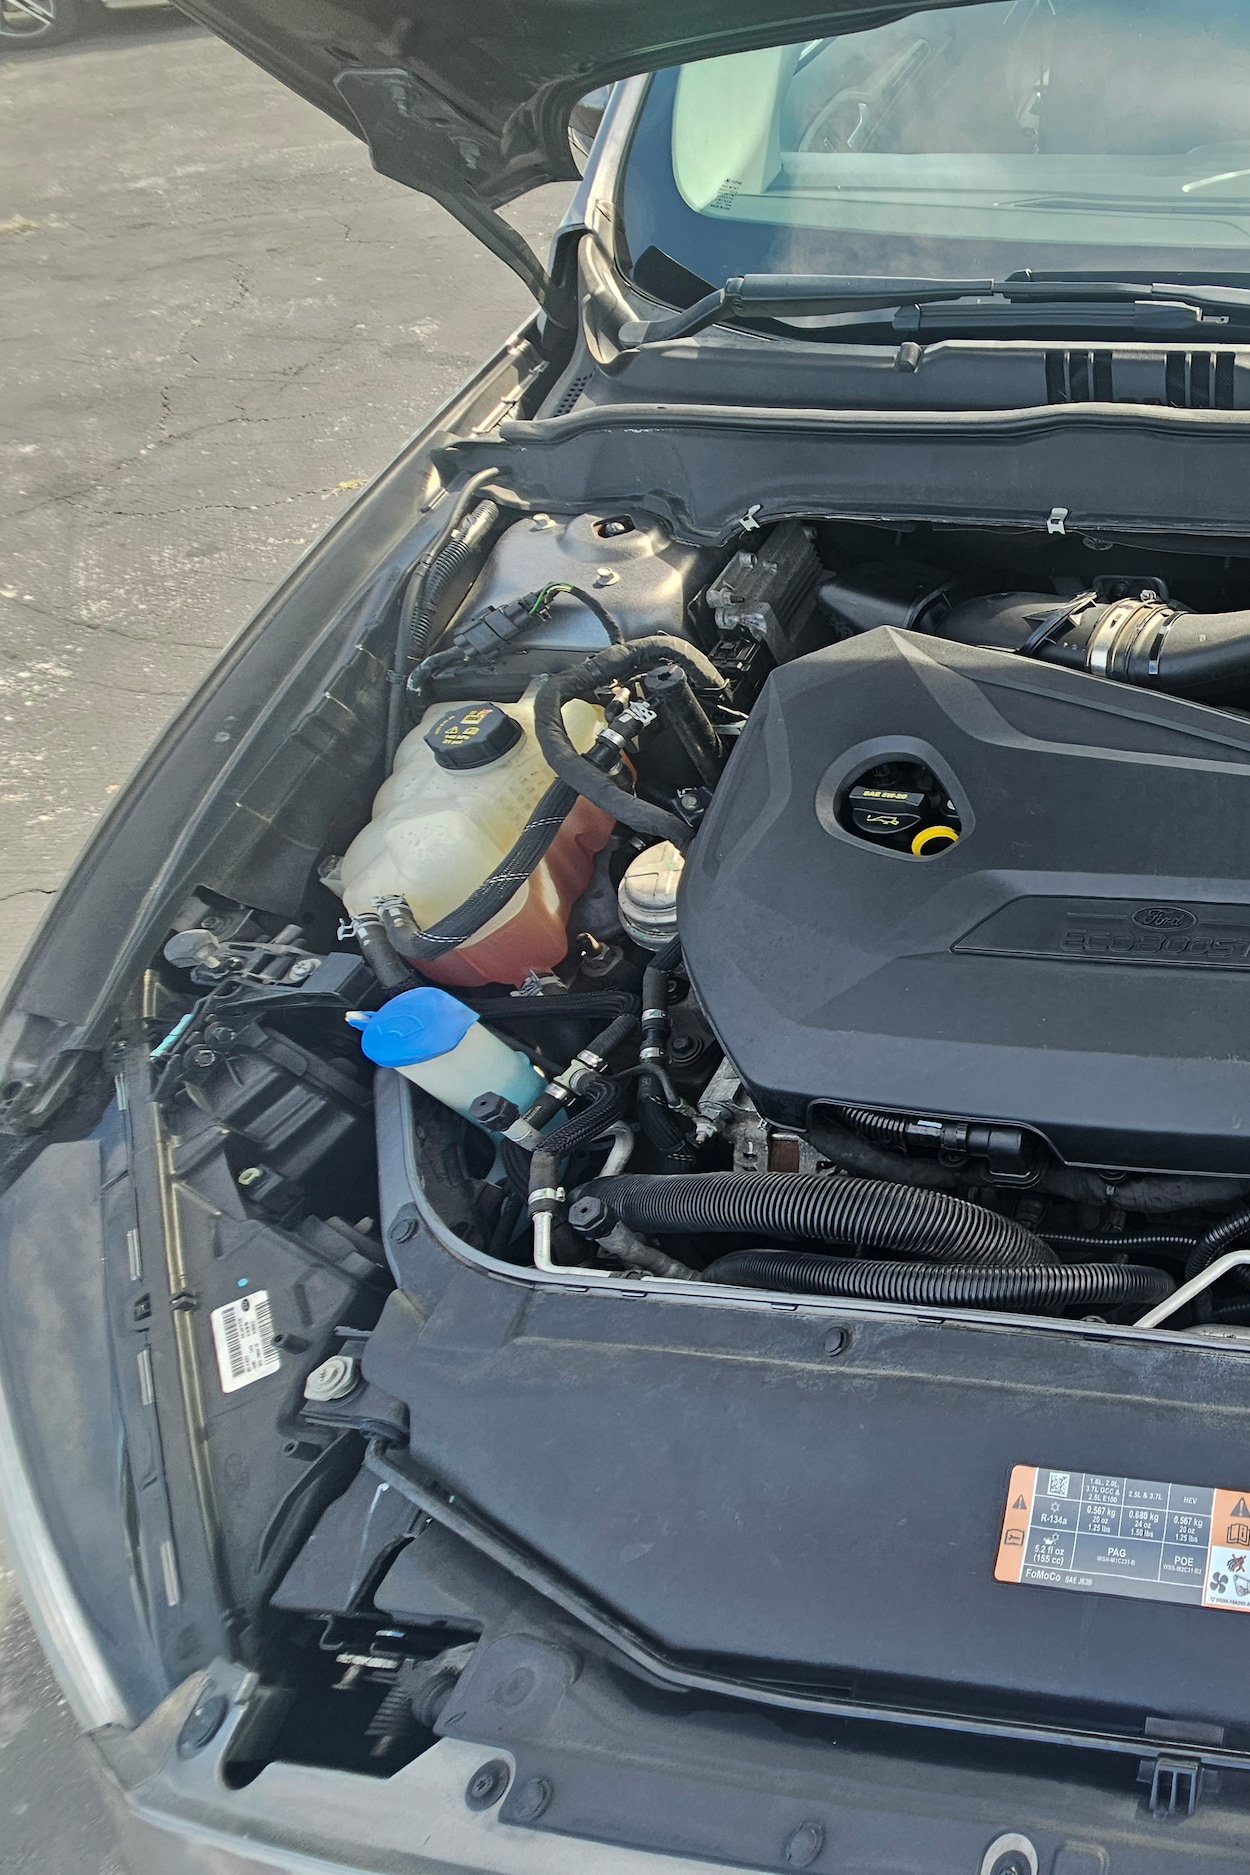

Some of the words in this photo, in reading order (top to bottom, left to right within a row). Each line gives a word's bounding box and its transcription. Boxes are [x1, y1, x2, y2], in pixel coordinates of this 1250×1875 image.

[1143, 909, 1184, 927] Ford
[1128, 1490, 1141, 1498] 2.5L
[1183, 1496, 1198, 1504] HEV
[1087, 1505, 1106, 1515] 0.567
[1107, 1508, 1116, 1518] kg
[1128, 1510, 1148, 1520] 0.680
[1149, 1512, 1159, 1523] kg
[1040, 1513, 1067, 1525] R-134a
[1134, 1520, 1142, 1528] 24
[1173, 1515, 1192, 1525] 0.567
[1193, 1518, 1203, 1528] kg
[1088, 1524, 1100, 1532] 1.25
[1101, 1525, 1111, 1533] lbs
[1144, 1530, 1154, 1538] lbs
[1175, 1534, 1188, 1542] 1.25
[1188, 1535, 1198, 1543] lbs
[1034, 1544, 1046, 1553] 5.2
[1047, 1545, 1054, 1554] fl
[1055, 1548, 1065, 1556] oz
[1107, 1547, 1126, 1557] PAG
[1033, 1553, 1050, 1563] (155
[1051, 1556, 1064, 1567] cc)
[1174, 1555, 1194, 1567] POE
[1025, 1568, 1061, 1581] FoMoCo
